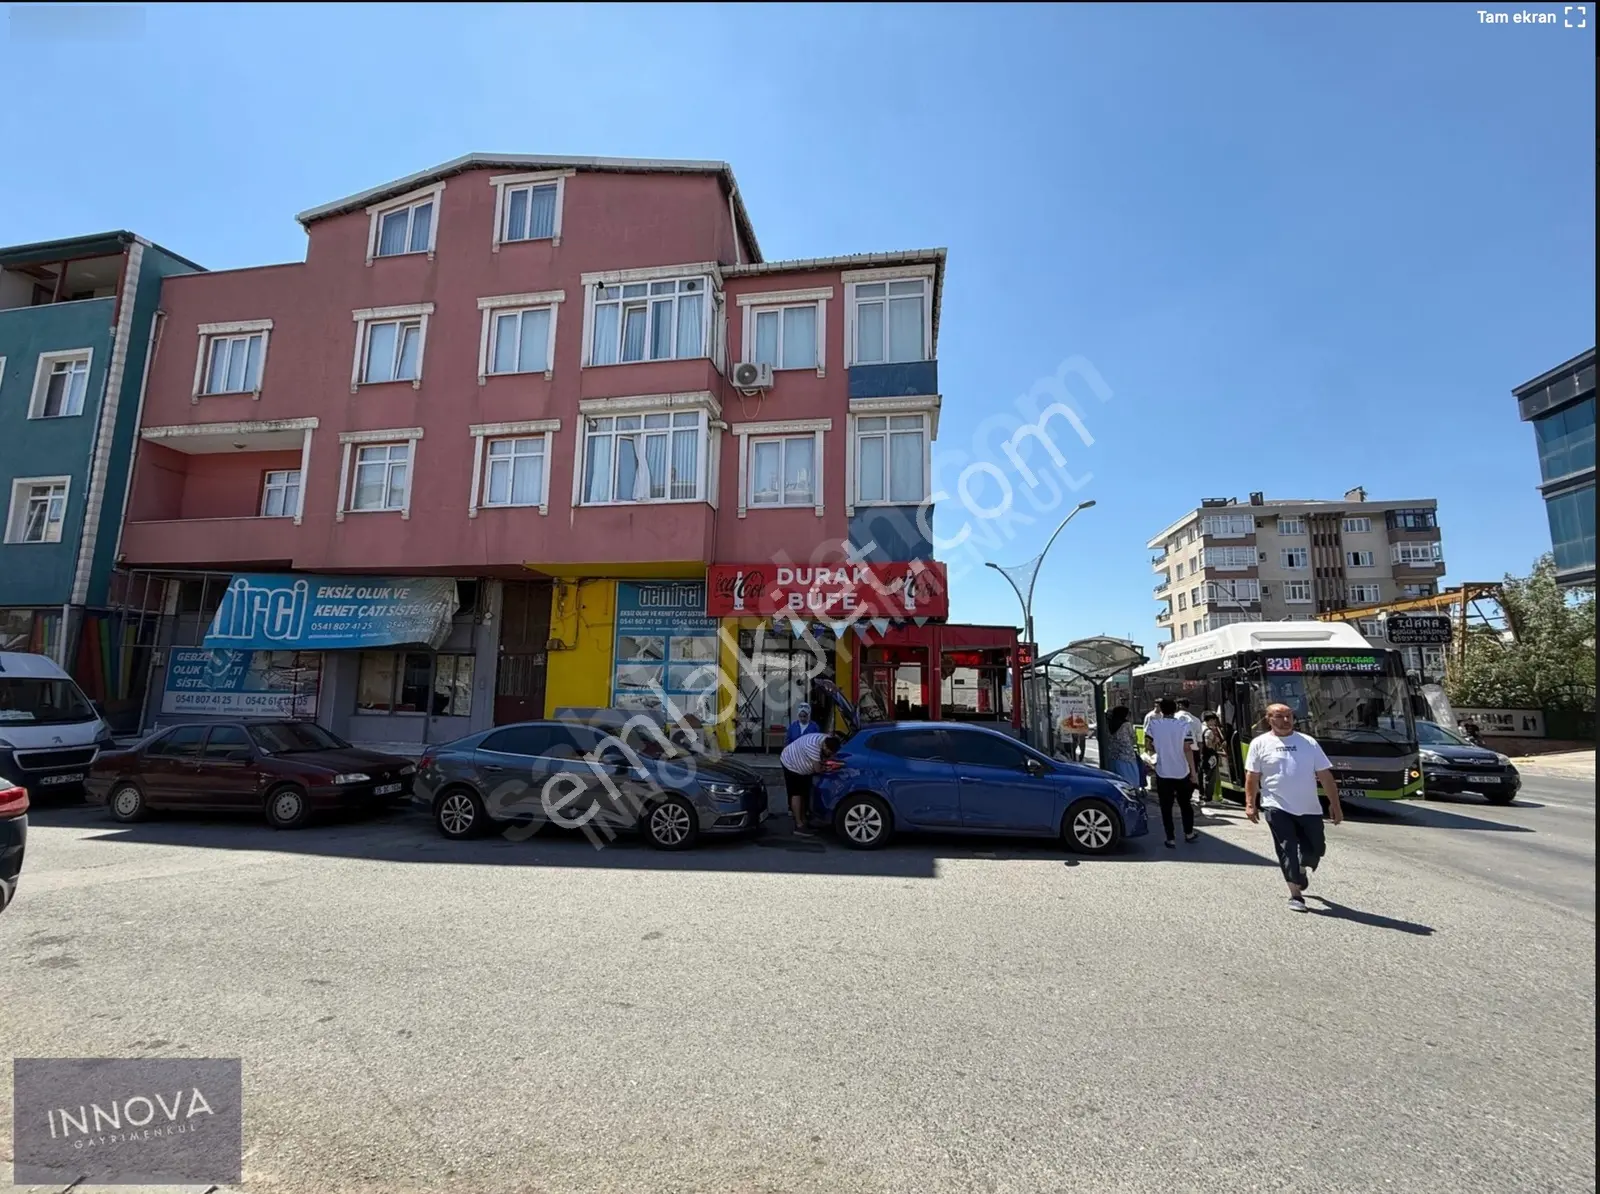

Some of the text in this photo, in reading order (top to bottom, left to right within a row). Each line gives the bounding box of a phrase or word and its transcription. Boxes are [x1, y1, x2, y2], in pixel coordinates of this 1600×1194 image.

[776, 568, 870, 585] DURAK
[317, 584, 410, 599] EKSİZ OLUK VE
[715, 571, 765, 598] CocaCola
[788, 588, 858, 611] BÜFE
[313, 604, 358, 617] KENET
[358, 604, 386, 619] ÇATI
[311, 622, 332, 631] 0541
[333, 621, 350, 630] 807
[351, 621, 361, 630] 41
[361, 621, 373, 629] 25
[173, 665, 202, 674] OLUK
[176, 695, 194, 704] 0541
[195, 695, 211, 704] 807
[211, 695, 221, 704] 41
[222, 696, 232, 704] 25
[245, 696, 266, 705] 0542
